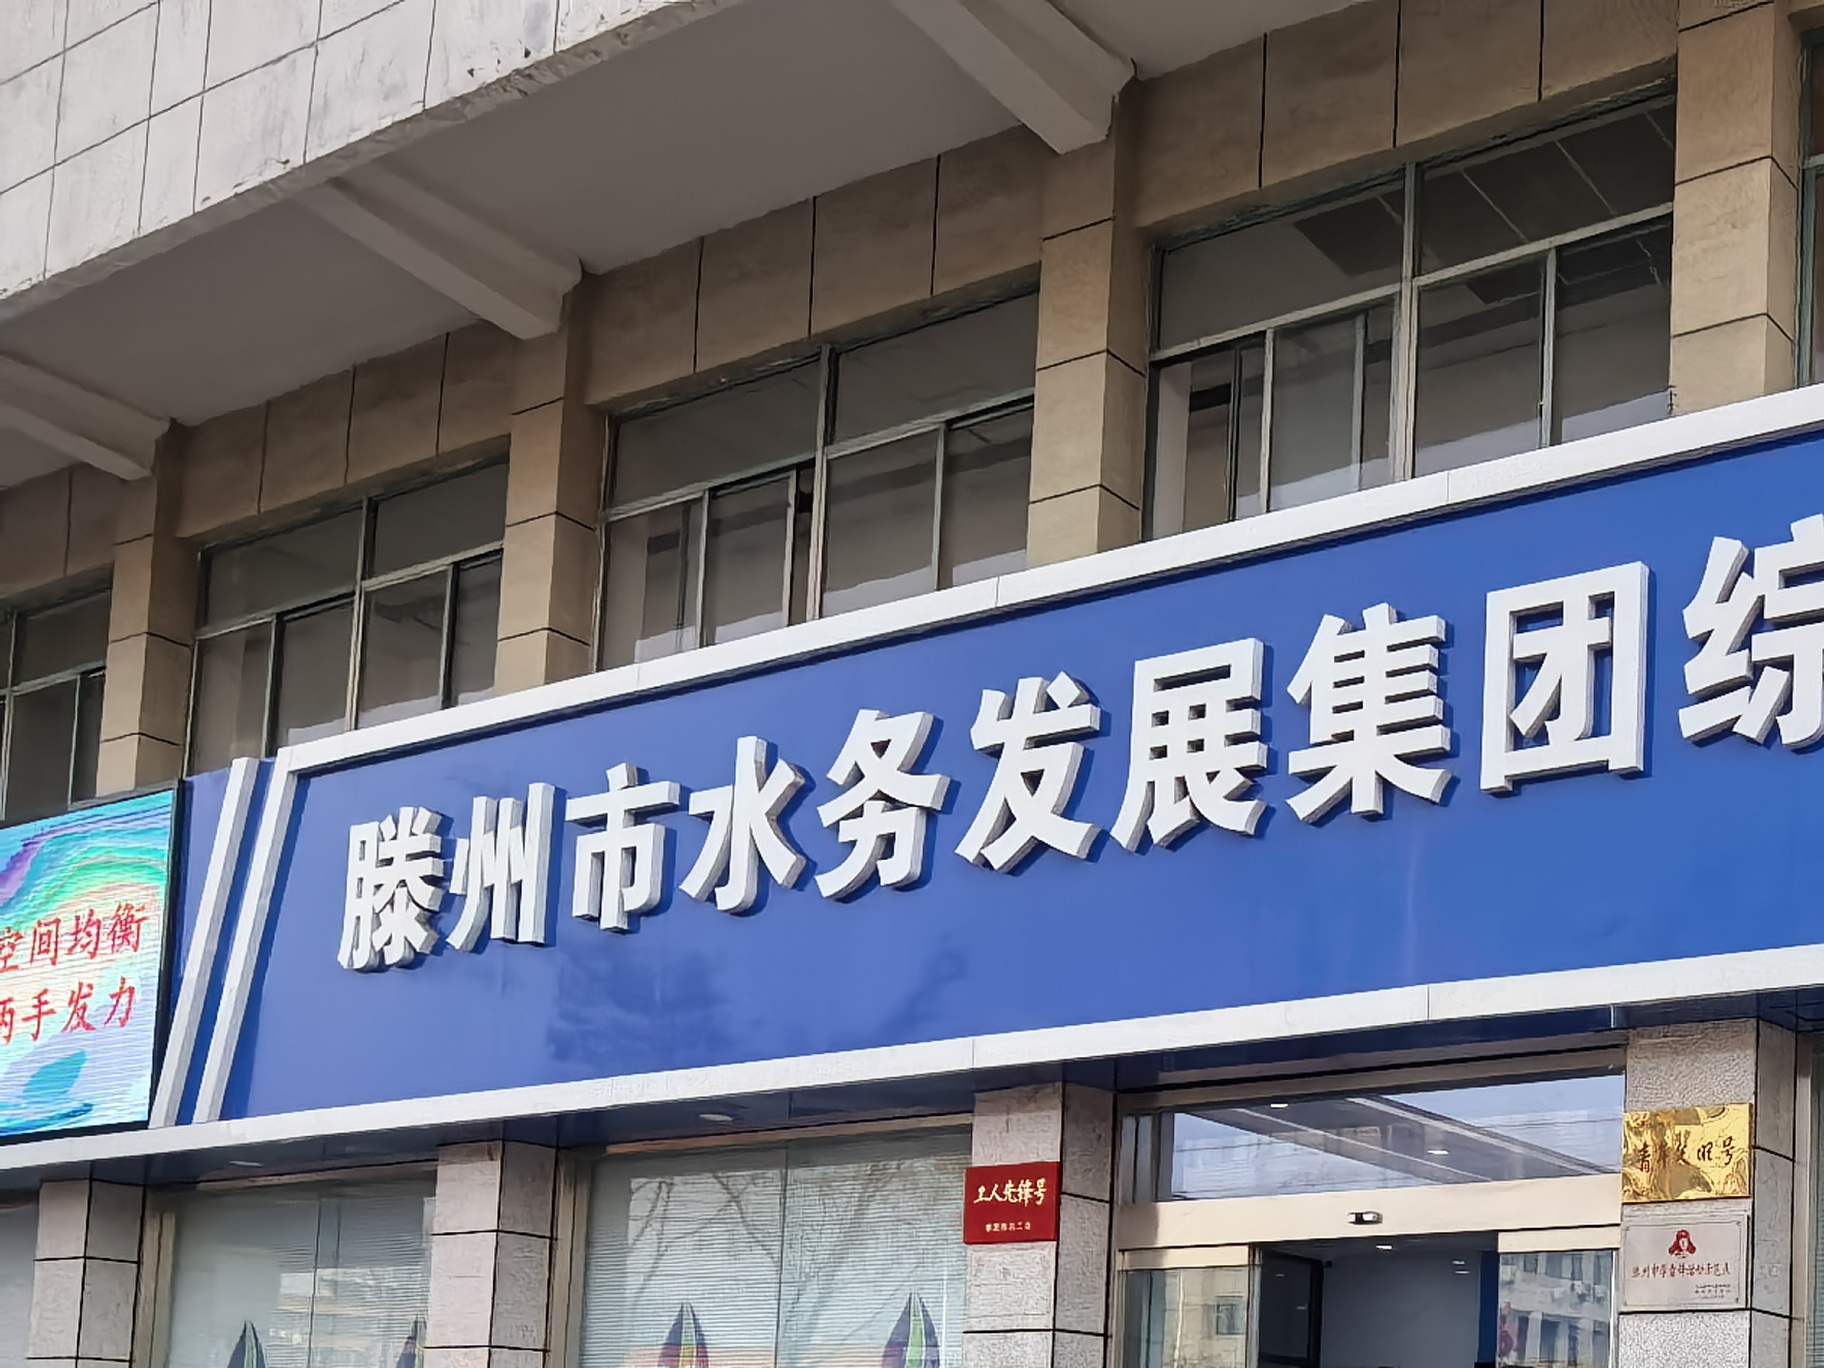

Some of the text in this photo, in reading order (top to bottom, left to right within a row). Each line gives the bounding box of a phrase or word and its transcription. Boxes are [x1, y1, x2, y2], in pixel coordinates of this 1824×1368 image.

[0, 902, 149, 972] 空间均衡
[973, 1177, 1047, 1208] 工人先锋号
